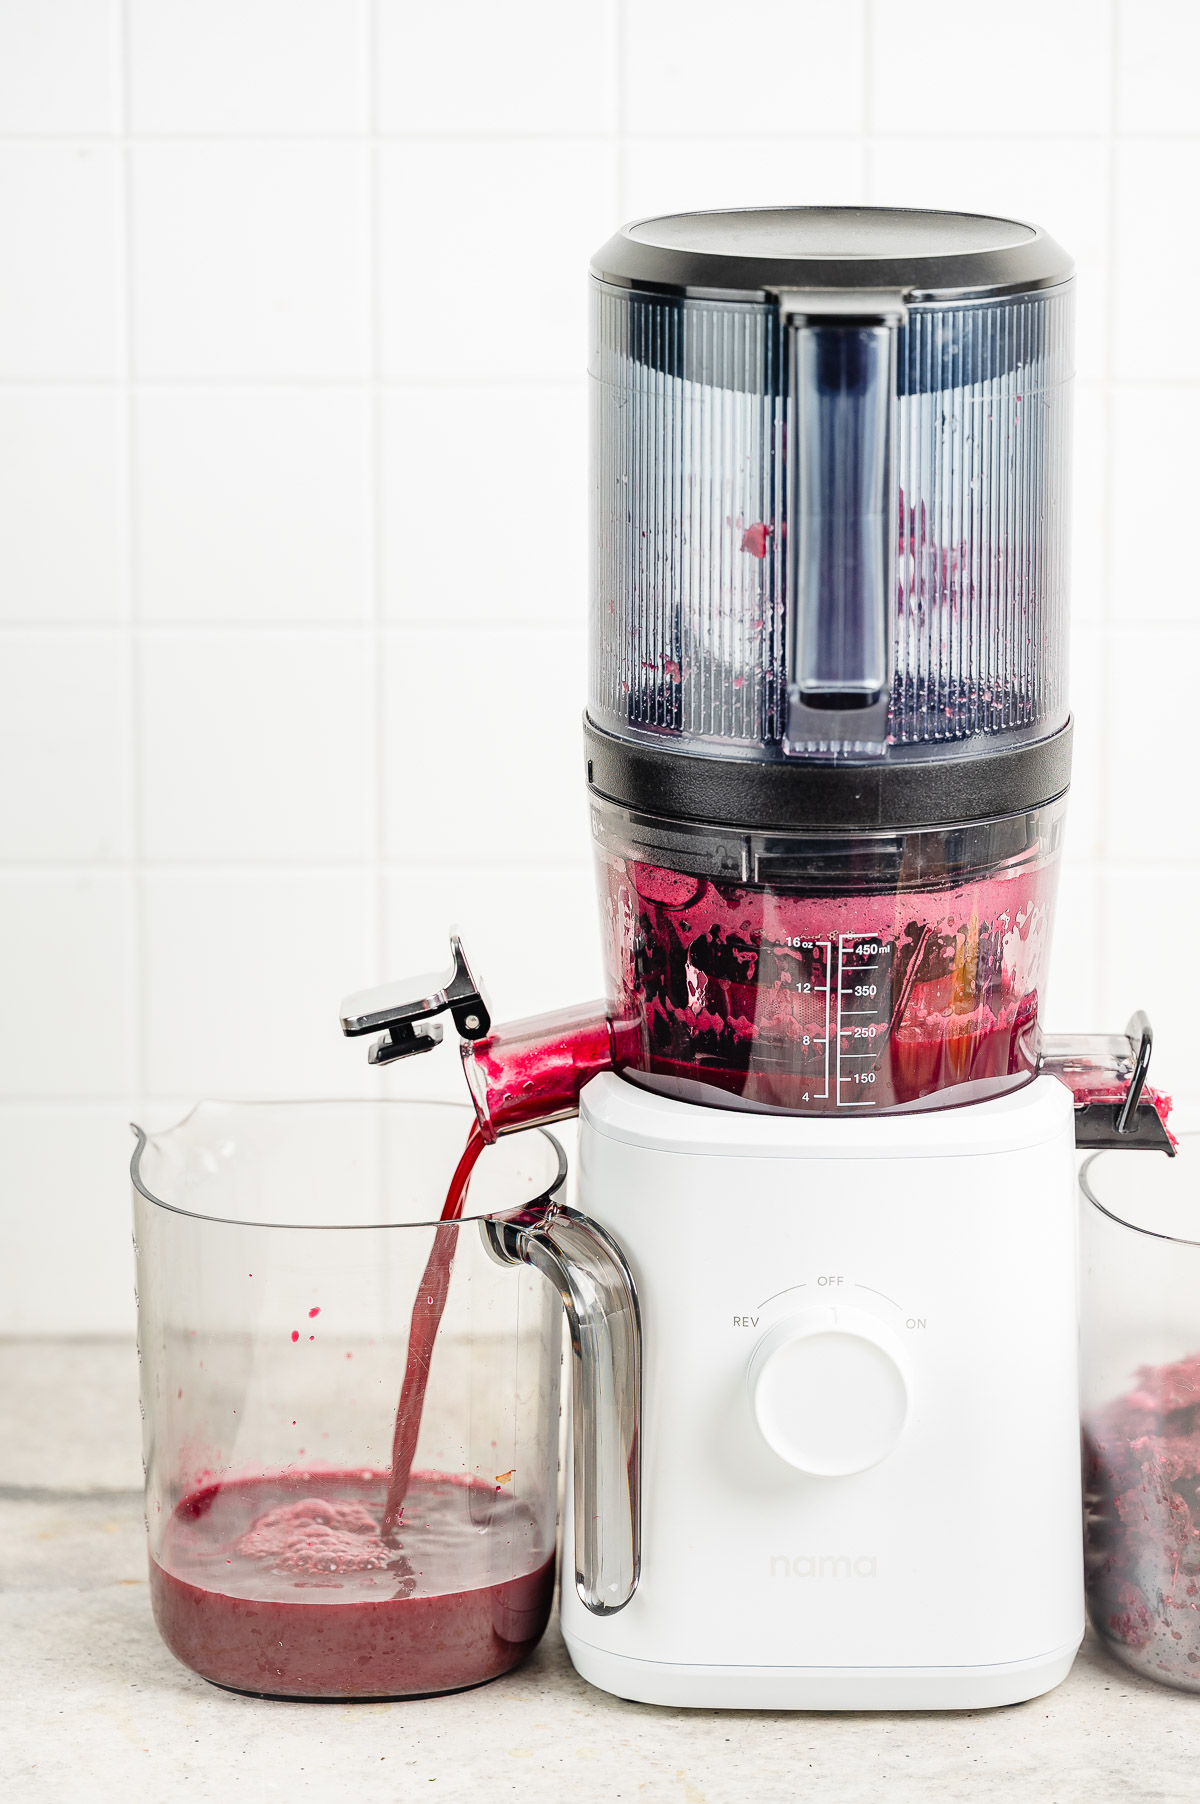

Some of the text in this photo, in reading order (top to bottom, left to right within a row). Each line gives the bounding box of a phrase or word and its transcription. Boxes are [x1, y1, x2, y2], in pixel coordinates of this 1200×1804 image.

[796, 983, 811, 993] 12
[854, 985, 877, 996] 350
[854, 1028, 876, 1038] 250
[802, 1036, 811, 1045] 8
[853, 1073, 876, 1083] 150
[801, 1092, 810, 1102] 4
[817, 1276, 844, 1287] OFF
[733, 1316, 760, 1328] REV
[905, 1318, 927, 1330] ON
[770, 1555, 877, 1577] nama
